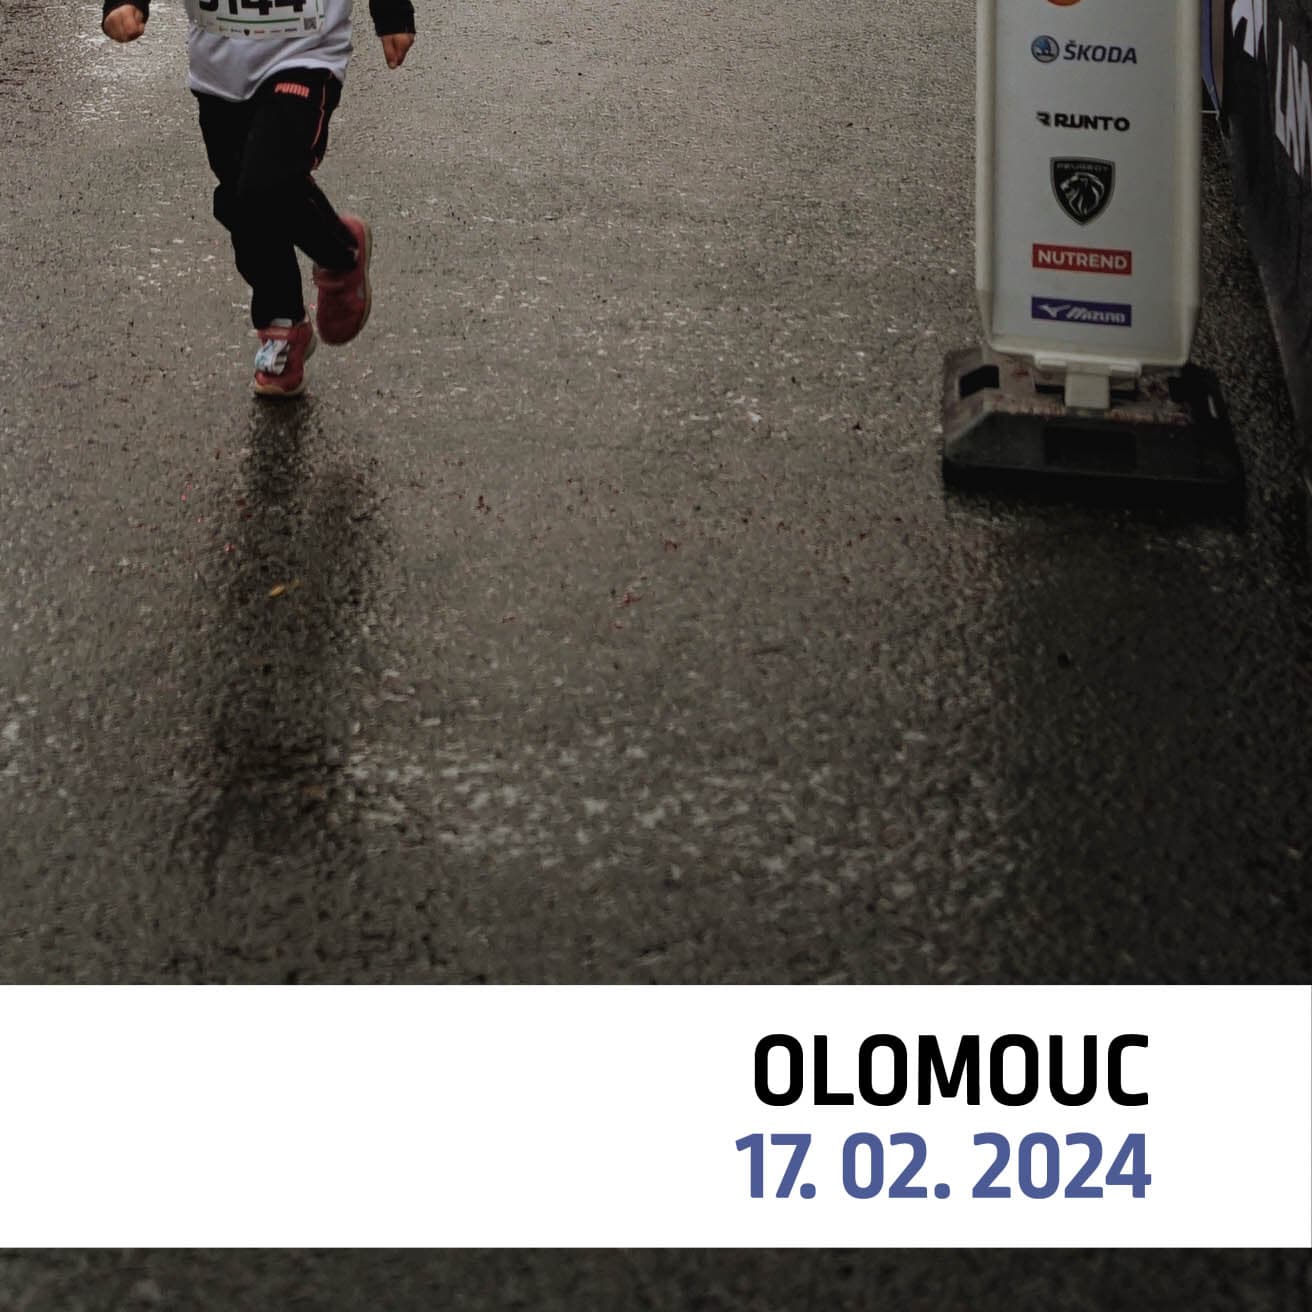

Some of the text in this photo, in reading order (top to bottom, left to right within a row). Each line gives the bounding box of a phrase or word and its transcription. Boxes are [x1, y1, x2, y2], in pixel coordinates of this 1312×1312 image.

[1063, 39, 1138, 64] ŠKODA
[1054, 113, 1130, 132] RUNTO
[1038, 248, 1128, 271] NUTREND
